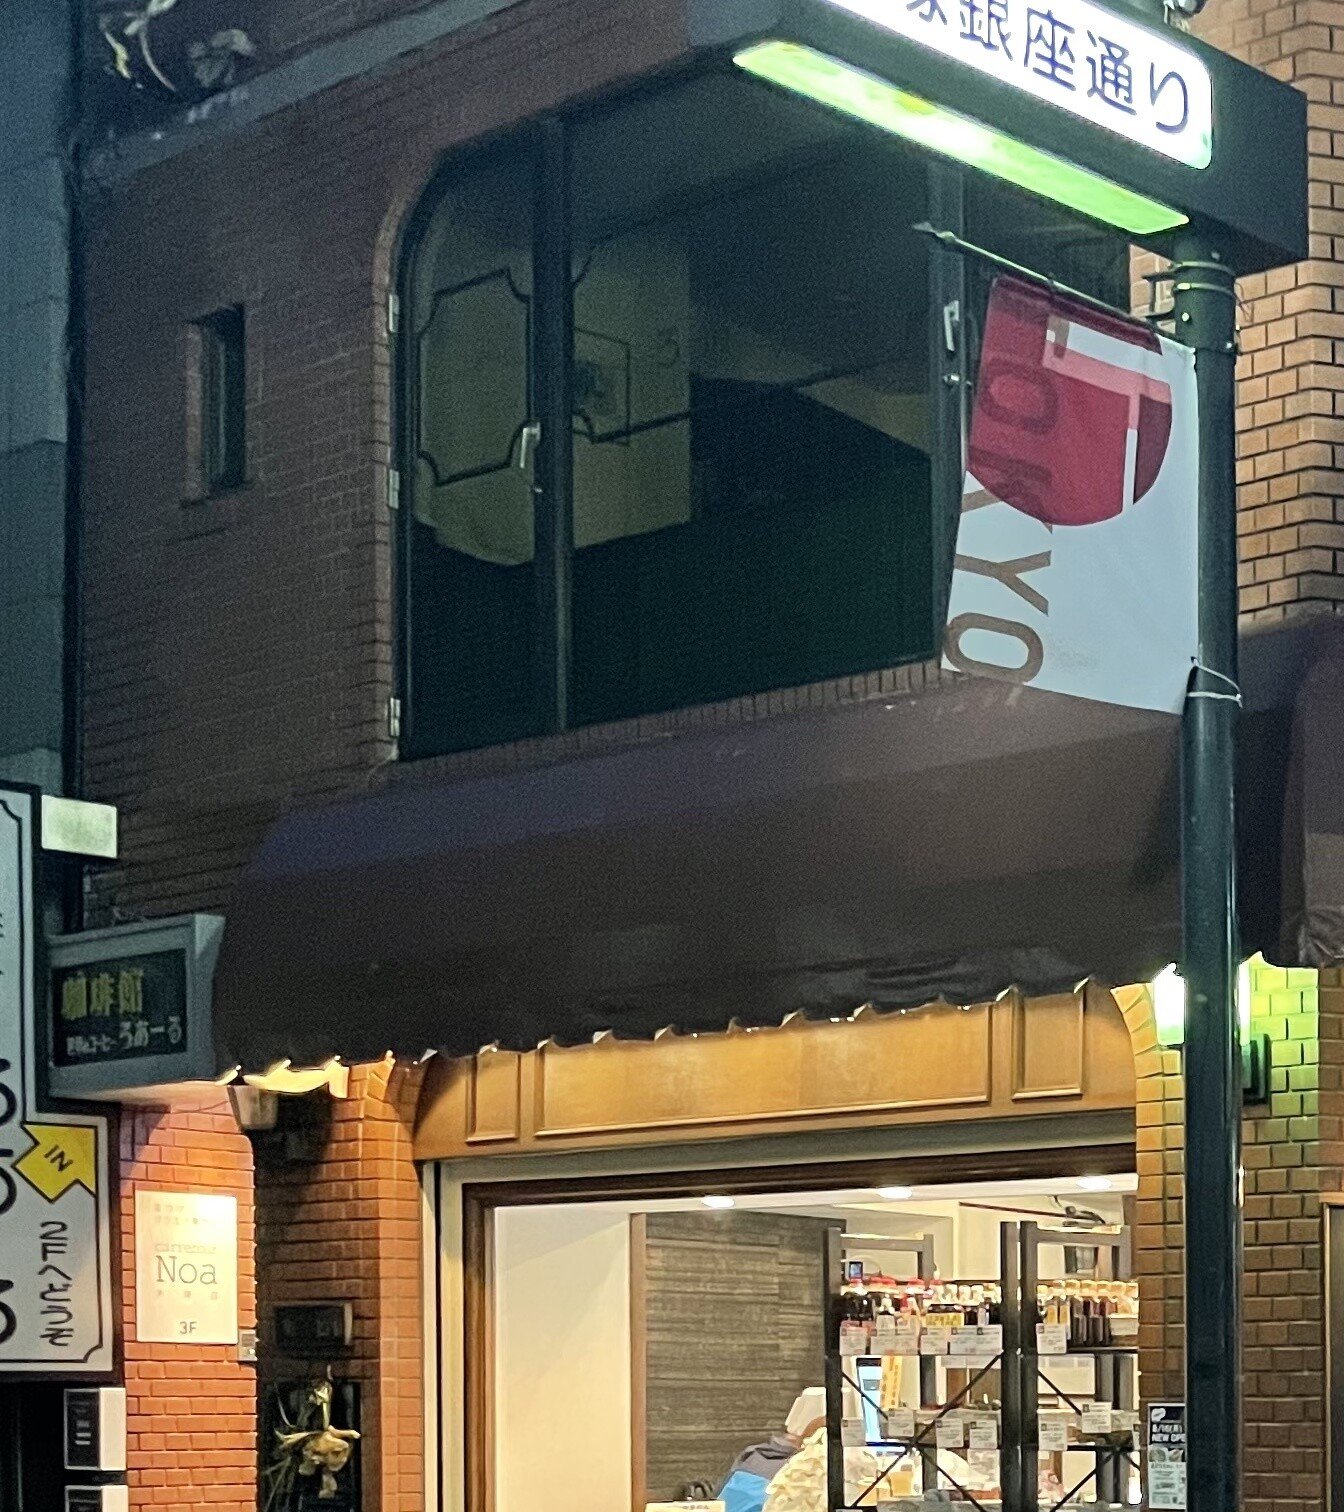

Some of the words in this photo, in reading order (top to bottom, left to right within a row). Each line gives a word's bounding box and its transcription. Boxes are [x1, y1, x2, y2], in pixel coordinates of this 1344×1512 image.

[44, 1144, 75, 1173] IN
[155, 1254, 219, 1286] Noa
[178, 1320, 198, 1336] 3F
